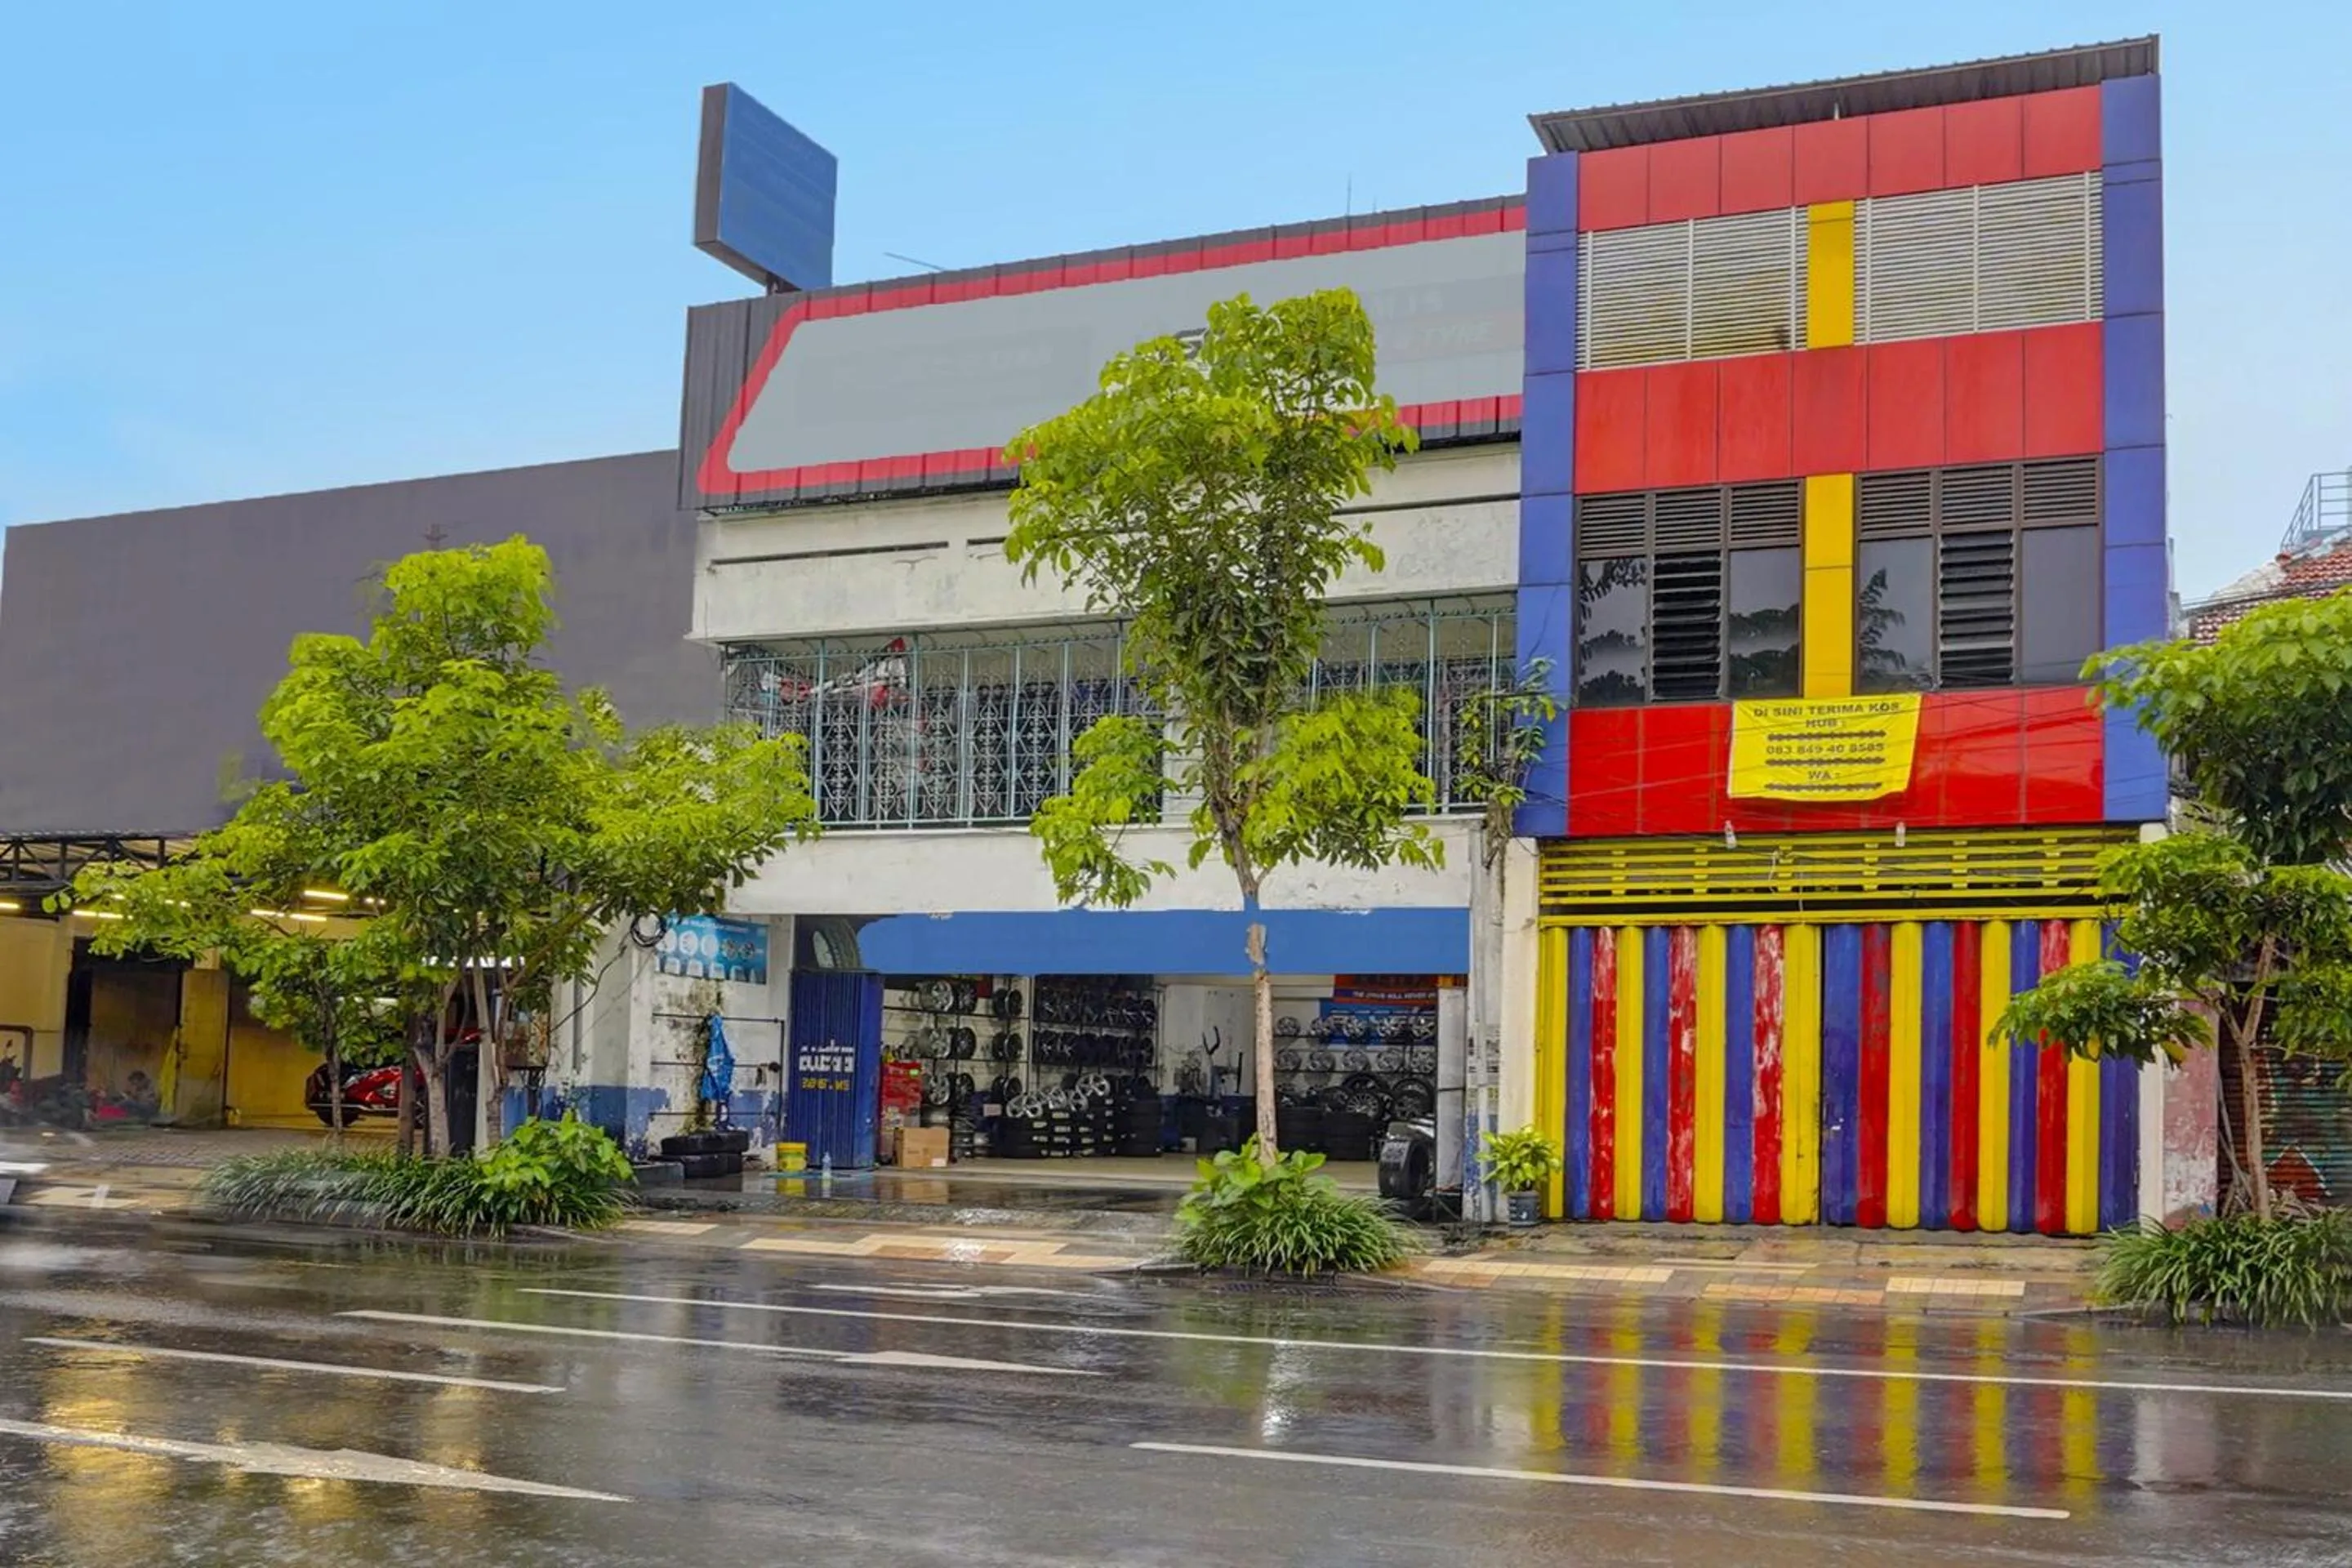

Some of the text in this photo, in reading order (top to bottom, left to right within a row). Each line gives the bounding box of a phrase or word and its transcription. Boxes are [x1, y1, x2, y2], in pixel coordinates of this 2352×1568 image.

[1754, 702, 1900, 717] DI SINI TERIMA KOS
[1808, 770, 1832, 780] WA
